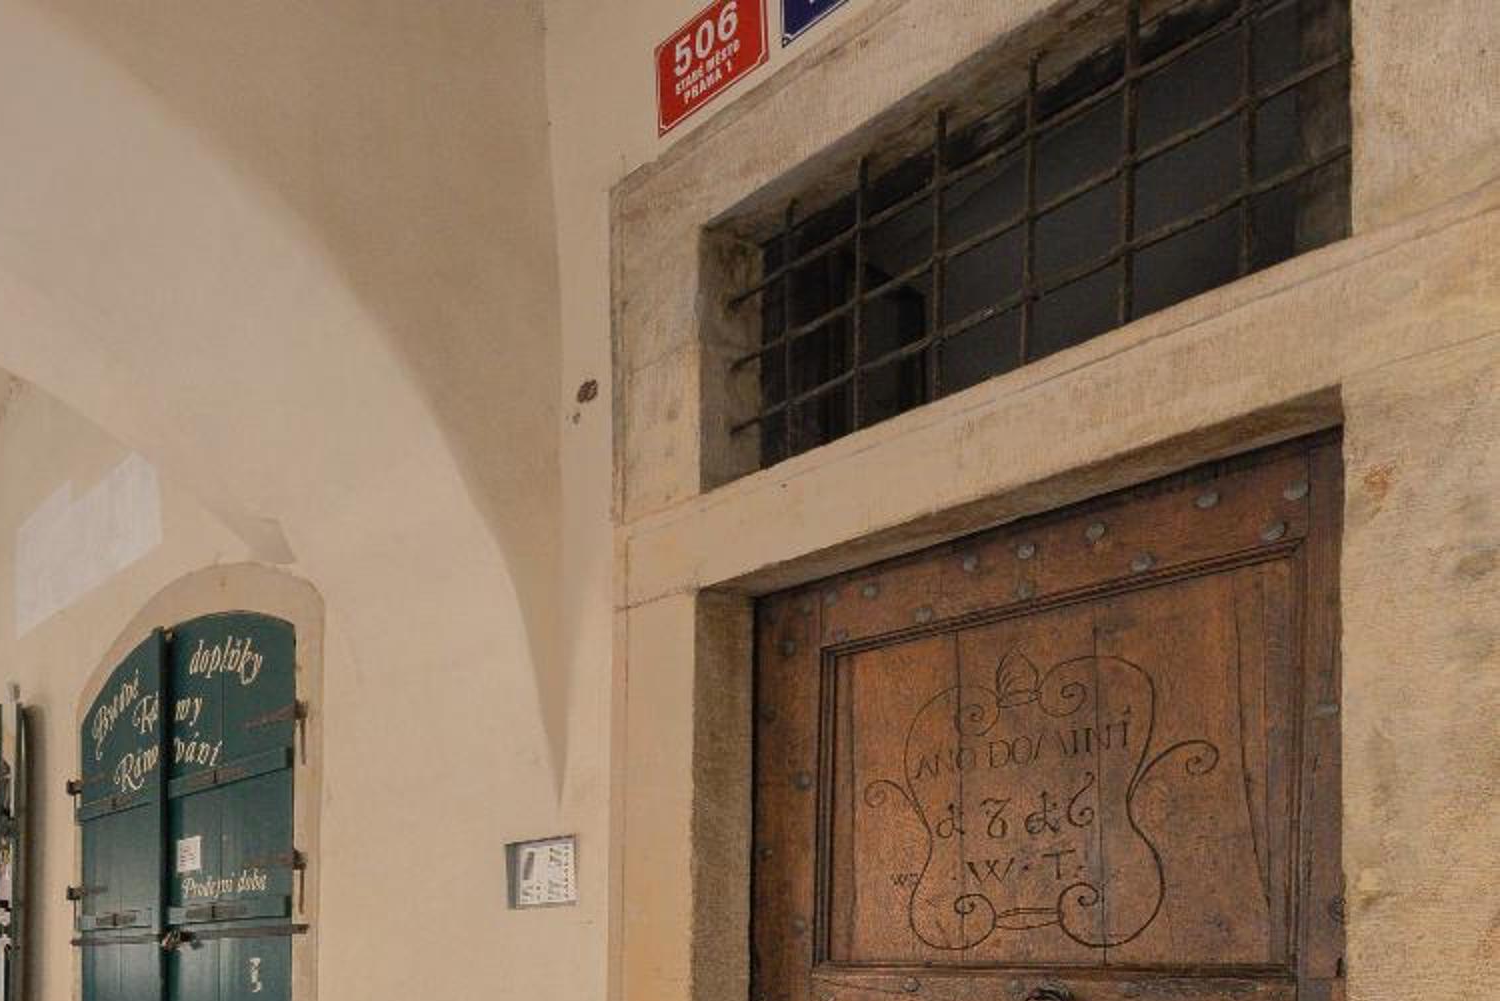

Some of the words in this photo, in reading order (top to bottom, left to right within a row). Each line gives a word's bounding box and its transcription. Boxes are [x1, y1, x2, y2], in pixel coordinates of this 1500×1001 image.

[673, 1, 739, 77] 506
[683, 68, 723, 105] PRAHA
[726, 59, 733, 73] 1
[188, 634, 264, 686] doplňky
[237, 867, 268, 894] doba
